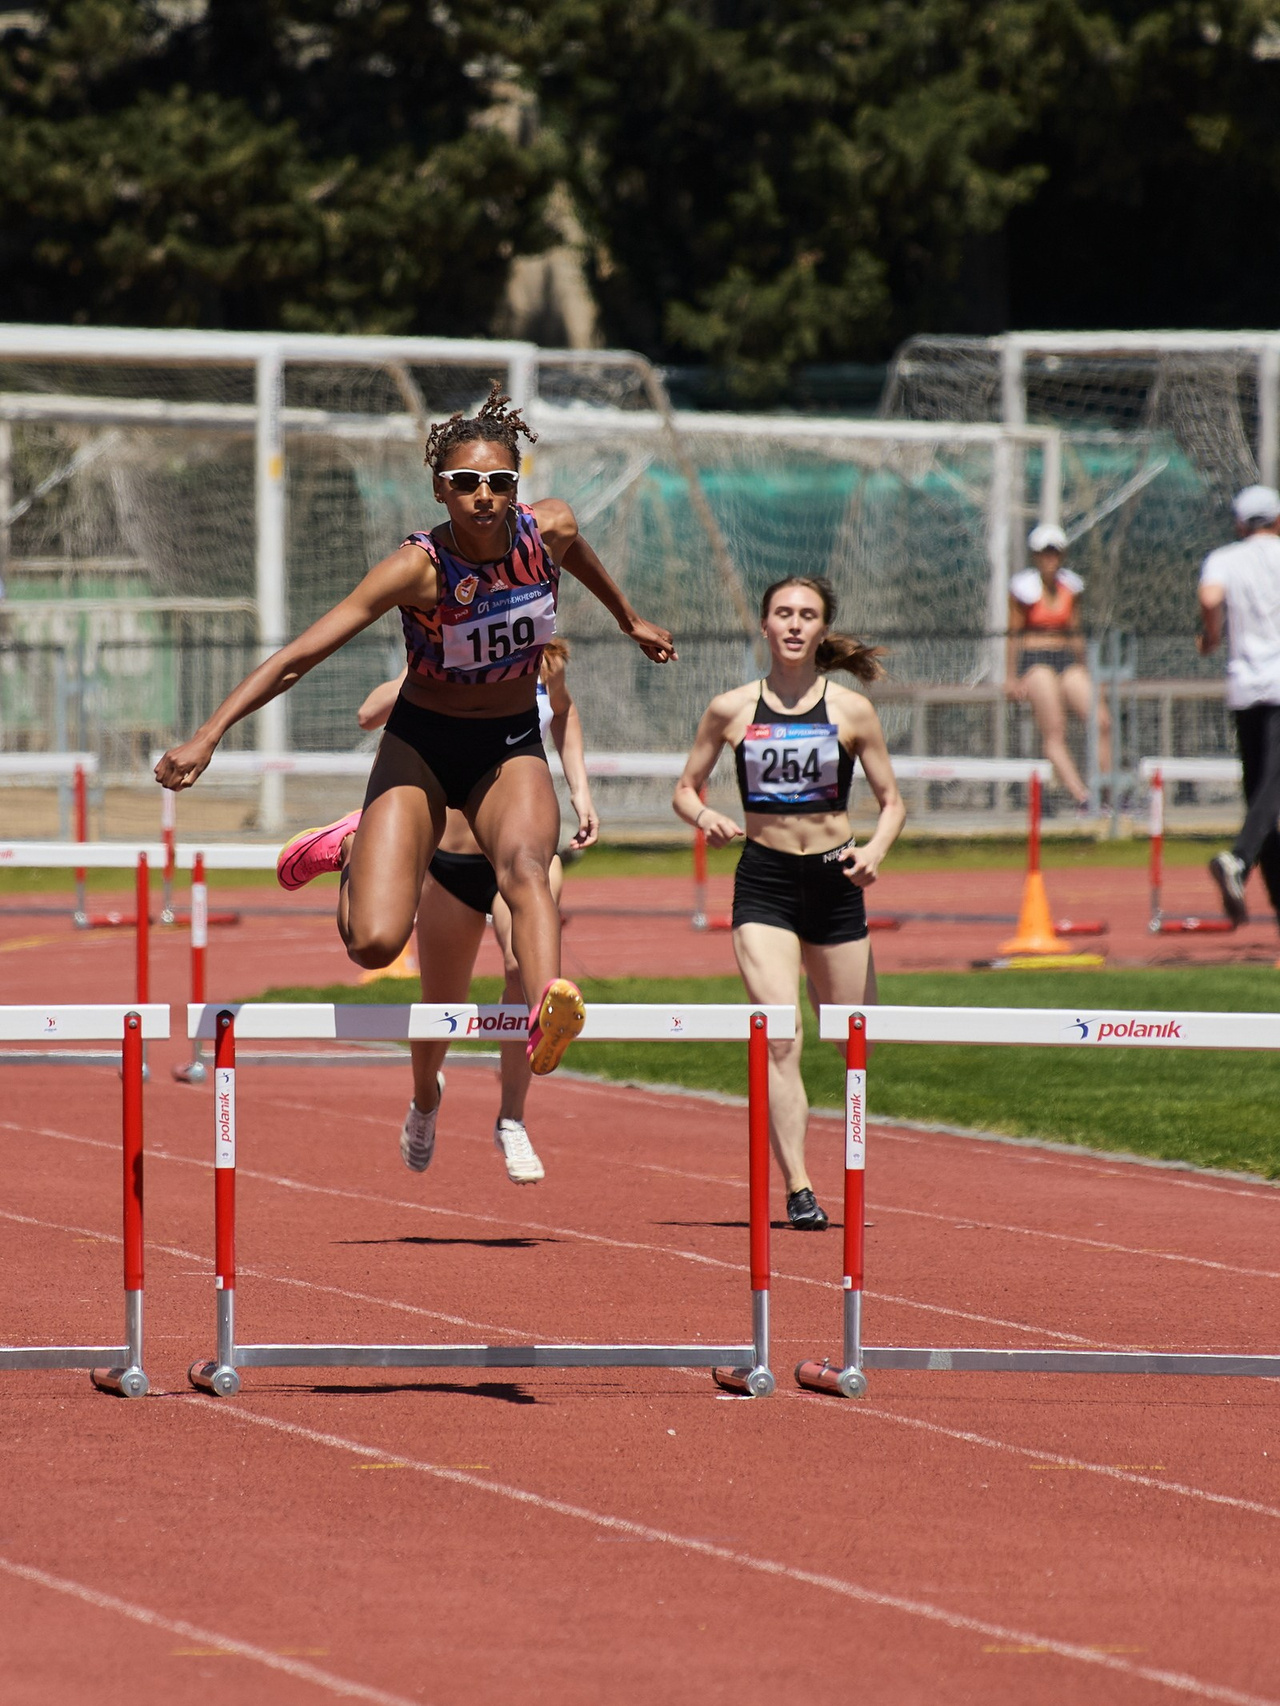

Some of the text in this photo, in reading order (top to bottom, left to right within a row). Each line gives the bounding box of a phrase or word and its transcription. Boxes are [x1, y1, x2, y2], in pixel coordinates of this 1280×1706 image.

[467, 616, 535, 662] 159
[762, 748, 822, 784] 254
[466, 1012, 528, 1035] polan
[1097, 1019, 1182, 1042] polanik
[219, 1093, 232, 1142] polanik
[851, 1093, 863, 1144] polanik
